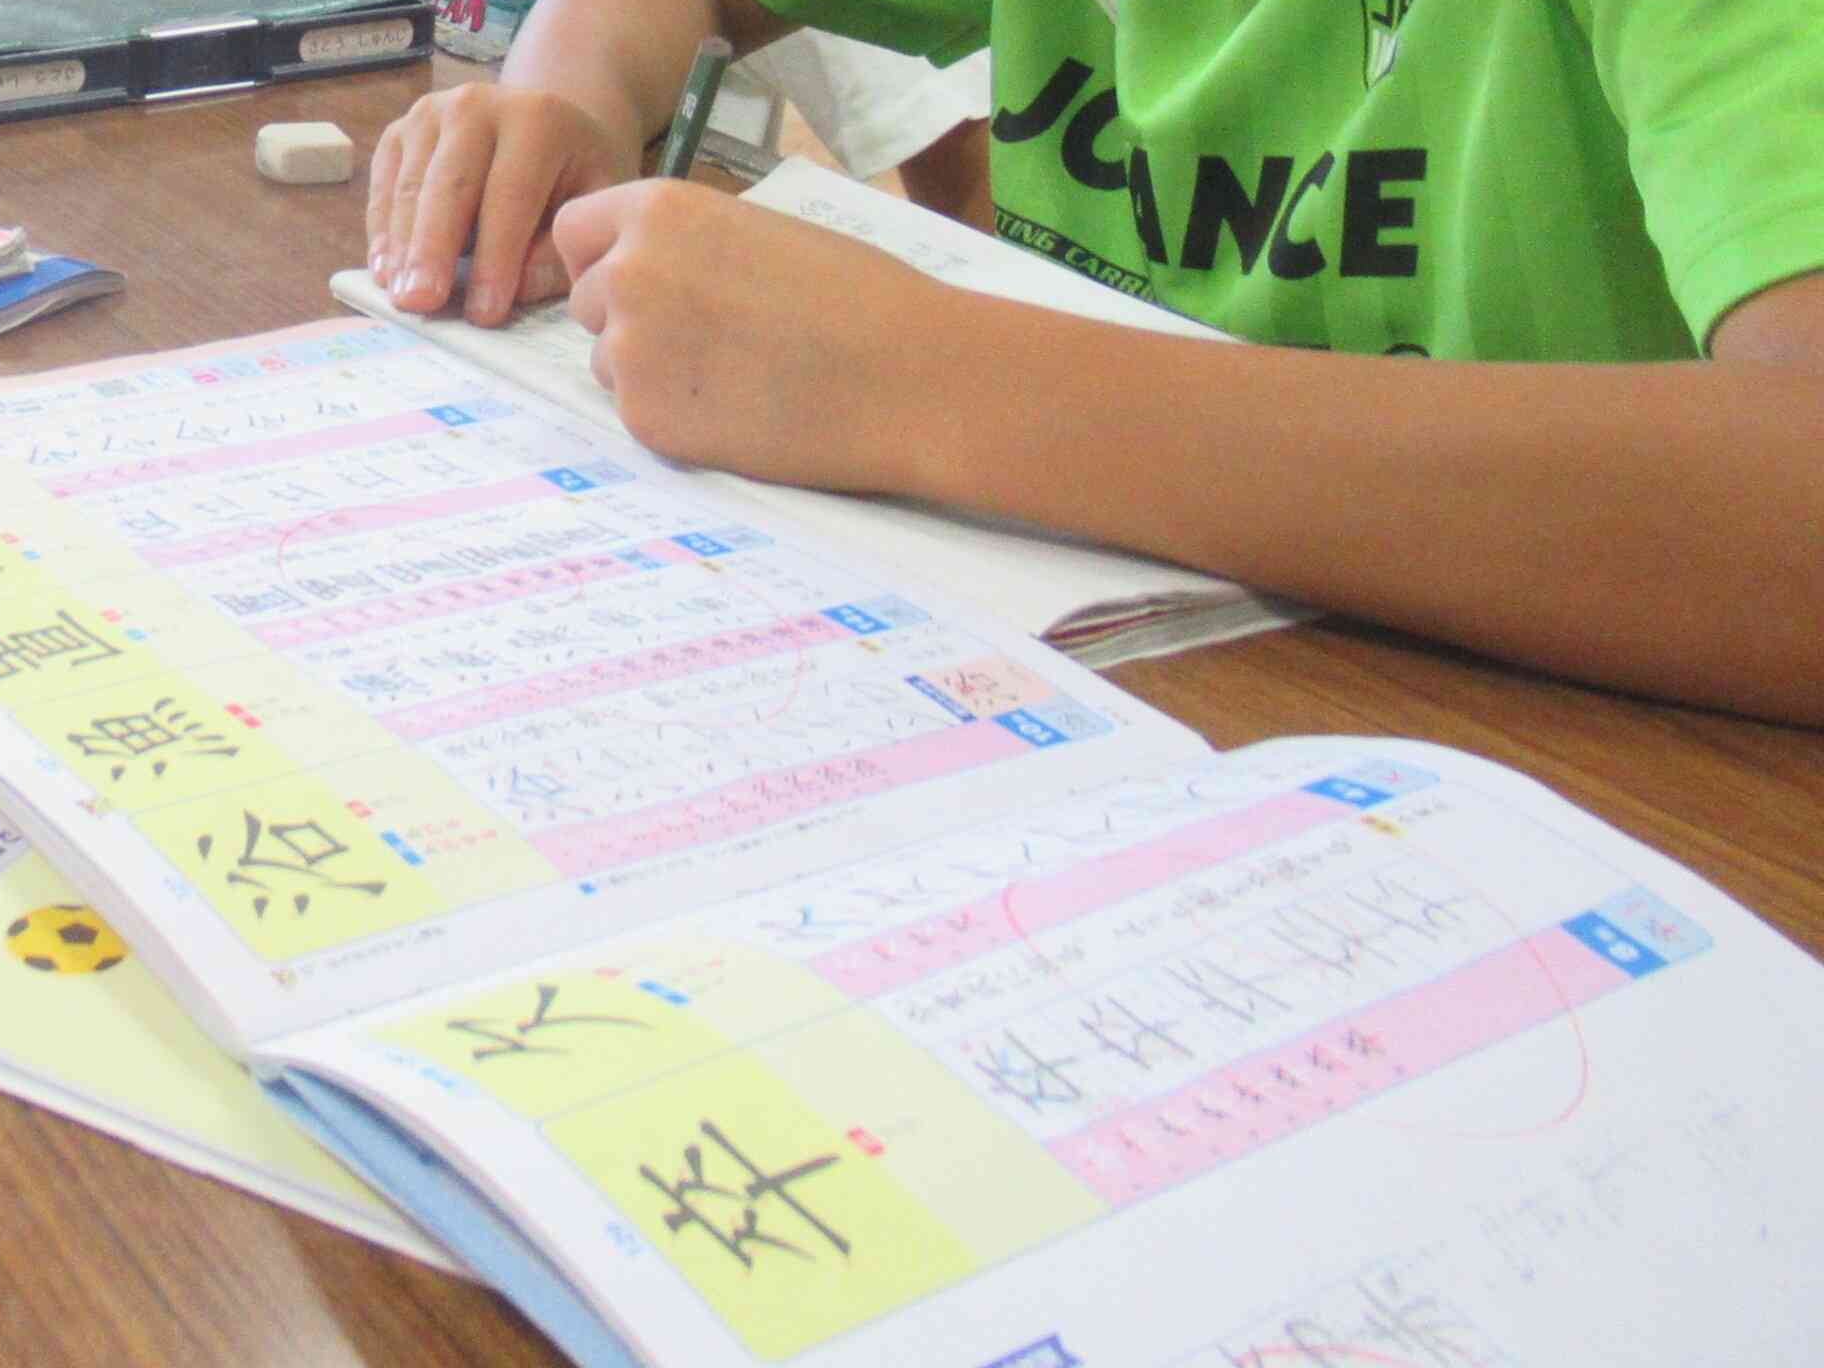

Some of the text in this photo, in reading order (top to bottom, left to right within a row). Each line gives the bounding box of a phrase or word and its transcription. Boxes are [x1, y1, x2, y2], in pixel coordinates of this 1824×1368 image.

[66, 696, 240, 781] 漁
[196, 809, 389, 919] 浴
[446, 983, 653, 1064] 欠
[638, 1118, 852, 1272] 卒
